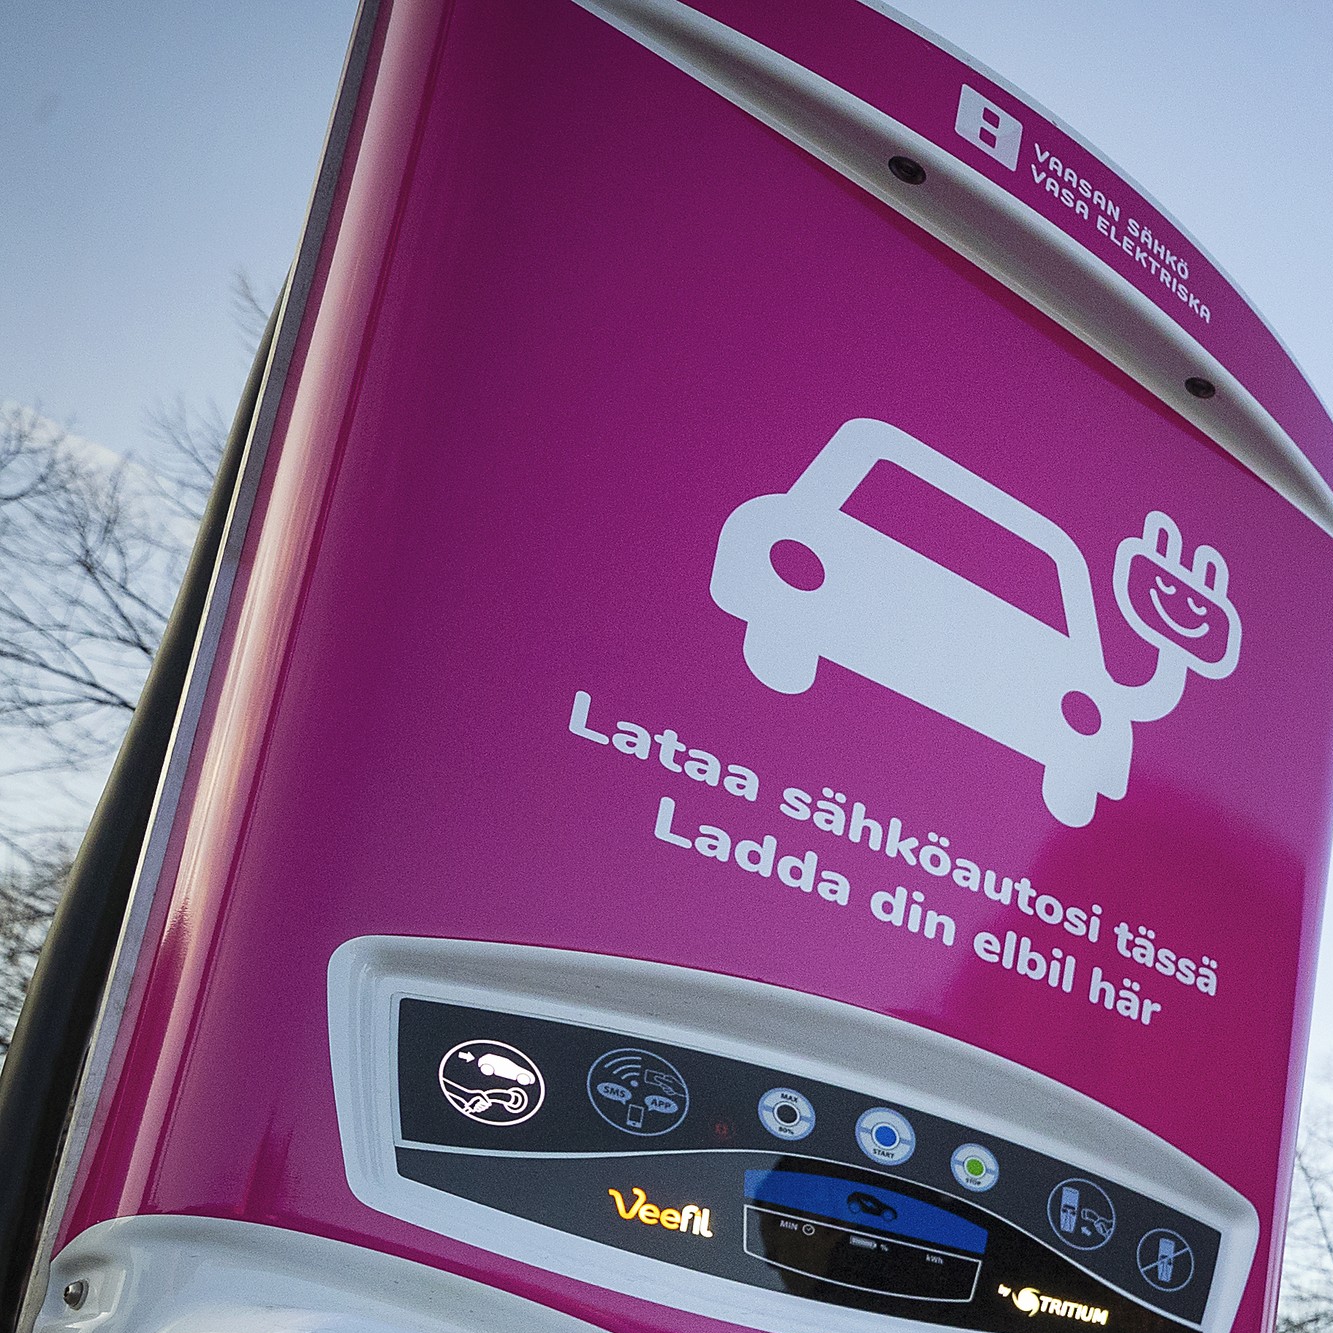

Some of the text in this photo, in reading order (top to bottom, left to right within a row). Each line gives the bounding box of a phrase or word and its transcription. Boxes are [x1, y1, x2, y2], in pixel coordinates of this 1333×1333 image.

[1034, 142, 1189, 280] VAASAN SÄHKÖ
[1030, 163, 1211, 323] VASA ELEKTRISKA
[568, 690, 1219, 996] Lataa sähköautosi tässä
[653, 796, 1162, 1026] Ladda din elbil här
[603, 1085, 626, 1098] SMS
[780, 1092, 799, 1104] MAX
[651, 1098, 672, 1109] APP
[873, 1148, 895, 1160] START
[965, 1177, 982, 1186] STOP
[608, 1187, 713, 1238] Veefil
[780, 1219, 799, 1231] MIN
[925, 1253, 945, 1264] kWh
[997, 1283, 1109, 1326] by TRITIUM
